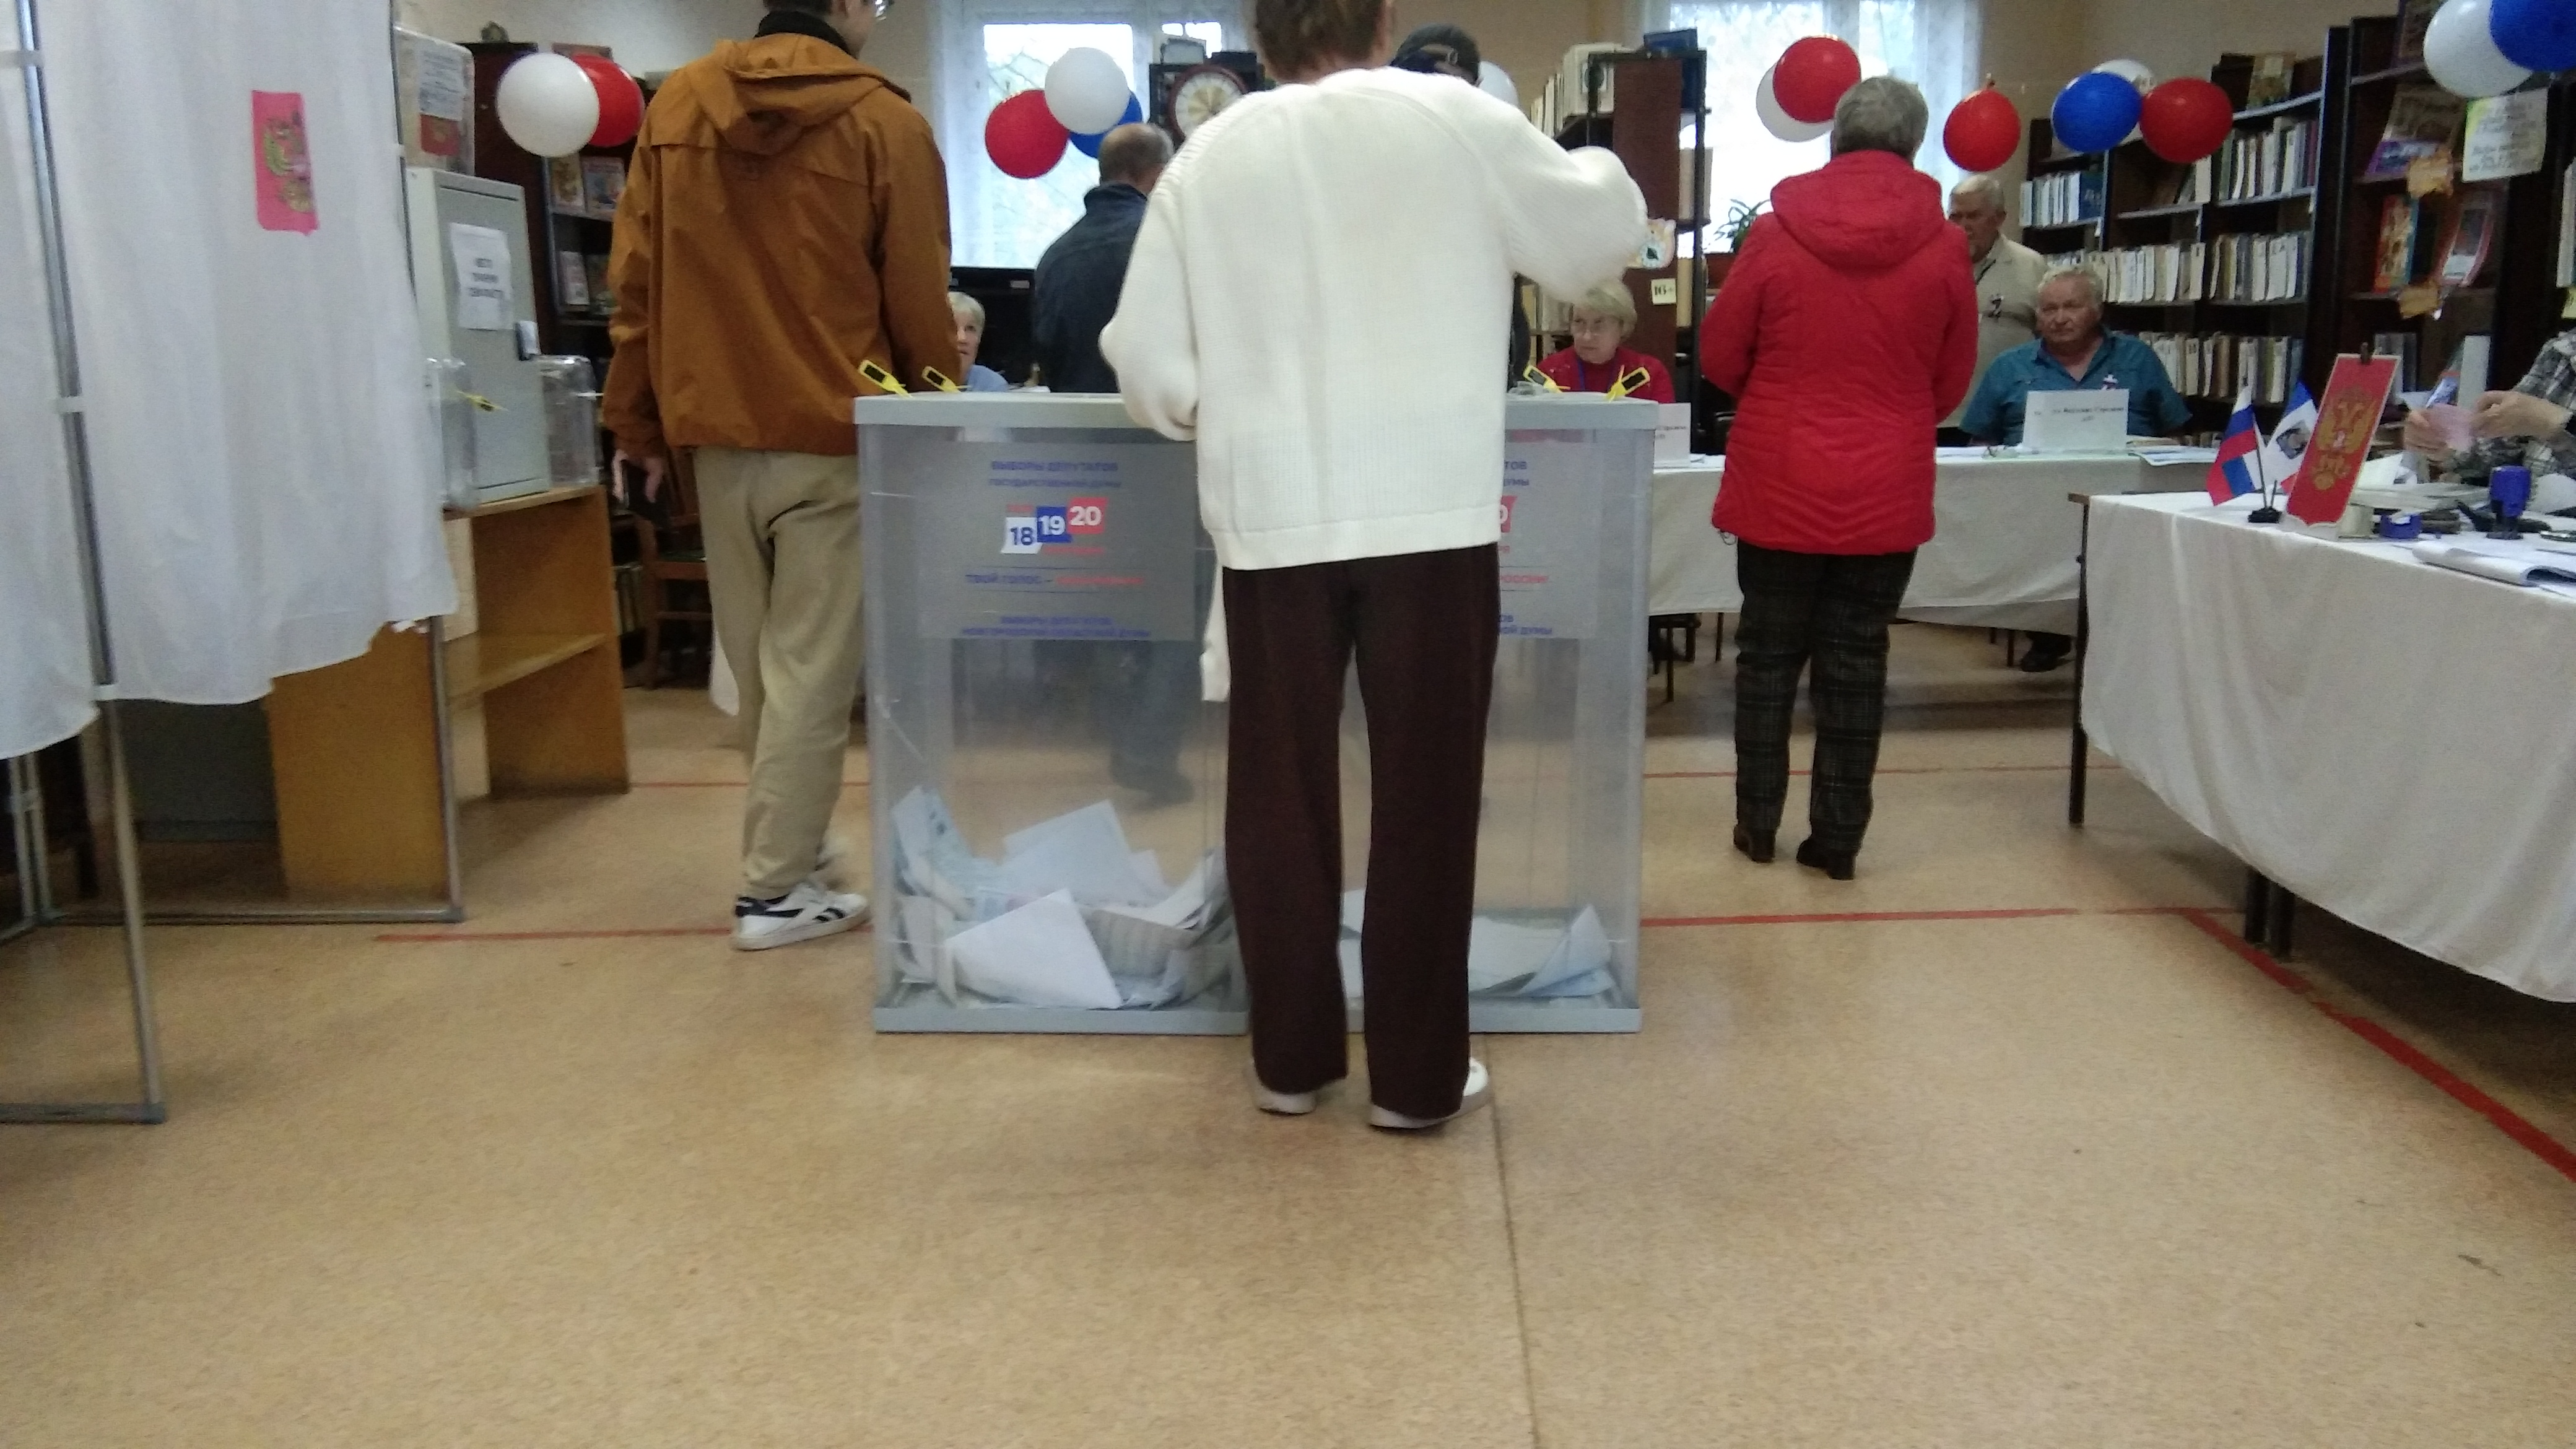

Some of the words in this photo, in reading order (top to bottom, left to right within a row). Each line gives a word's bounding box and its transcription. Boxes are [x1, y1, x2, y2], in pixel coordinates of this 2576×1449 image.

[1038, 515, 1066, 536] 19
[1069, 505, 1102, 526] 20
[1010, 527, 1033, 546] 18
